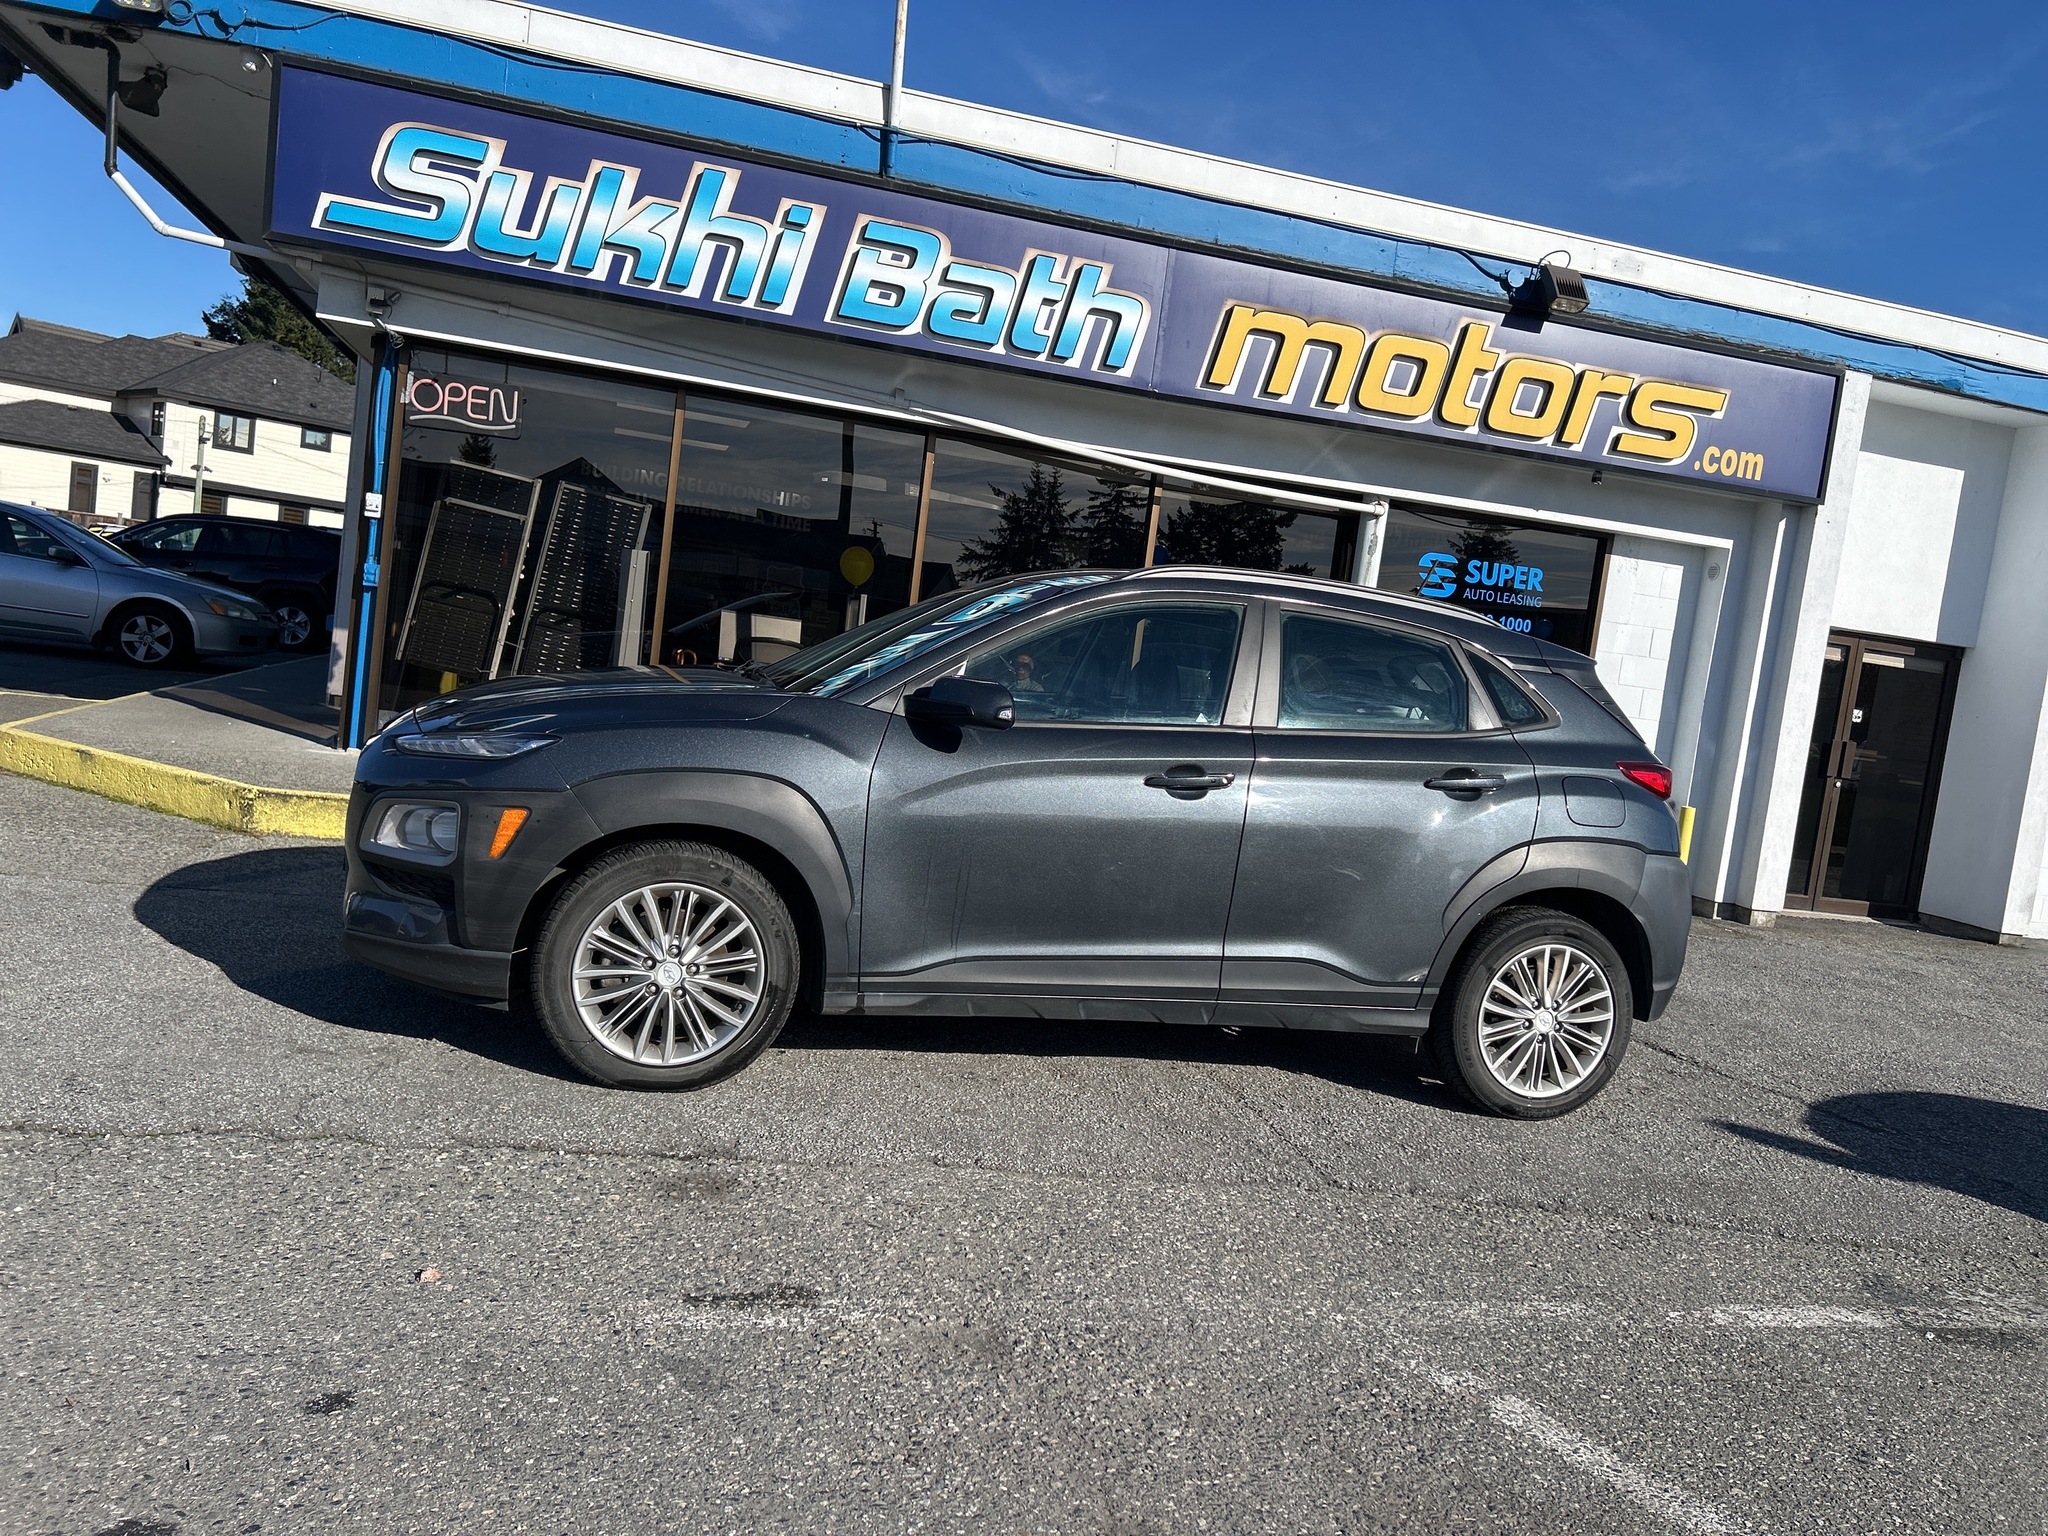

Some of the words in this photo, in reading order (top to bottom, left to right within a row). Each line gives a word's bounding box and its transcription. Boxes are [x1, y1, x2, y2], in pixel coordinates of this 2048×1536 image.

[311, 121, 827, 316] Sukhi
[824, 213, 1152, 378] Bath
[1195, 299, 1730, 467] motors
[1694, 446, 1764, 481] .com
[410, 379, 518, 424] OPEN
[580, 462, 668, 488] BUILDING
[676, 475, 812, 509] RELATIONSHIPS
[771, 512, 812, 533] TIME
[1464, 559, 1544, 592] SUPER
[1463, 587, 1495, 602] AUTO
[1496, 592, 1543, 608] LEASING
